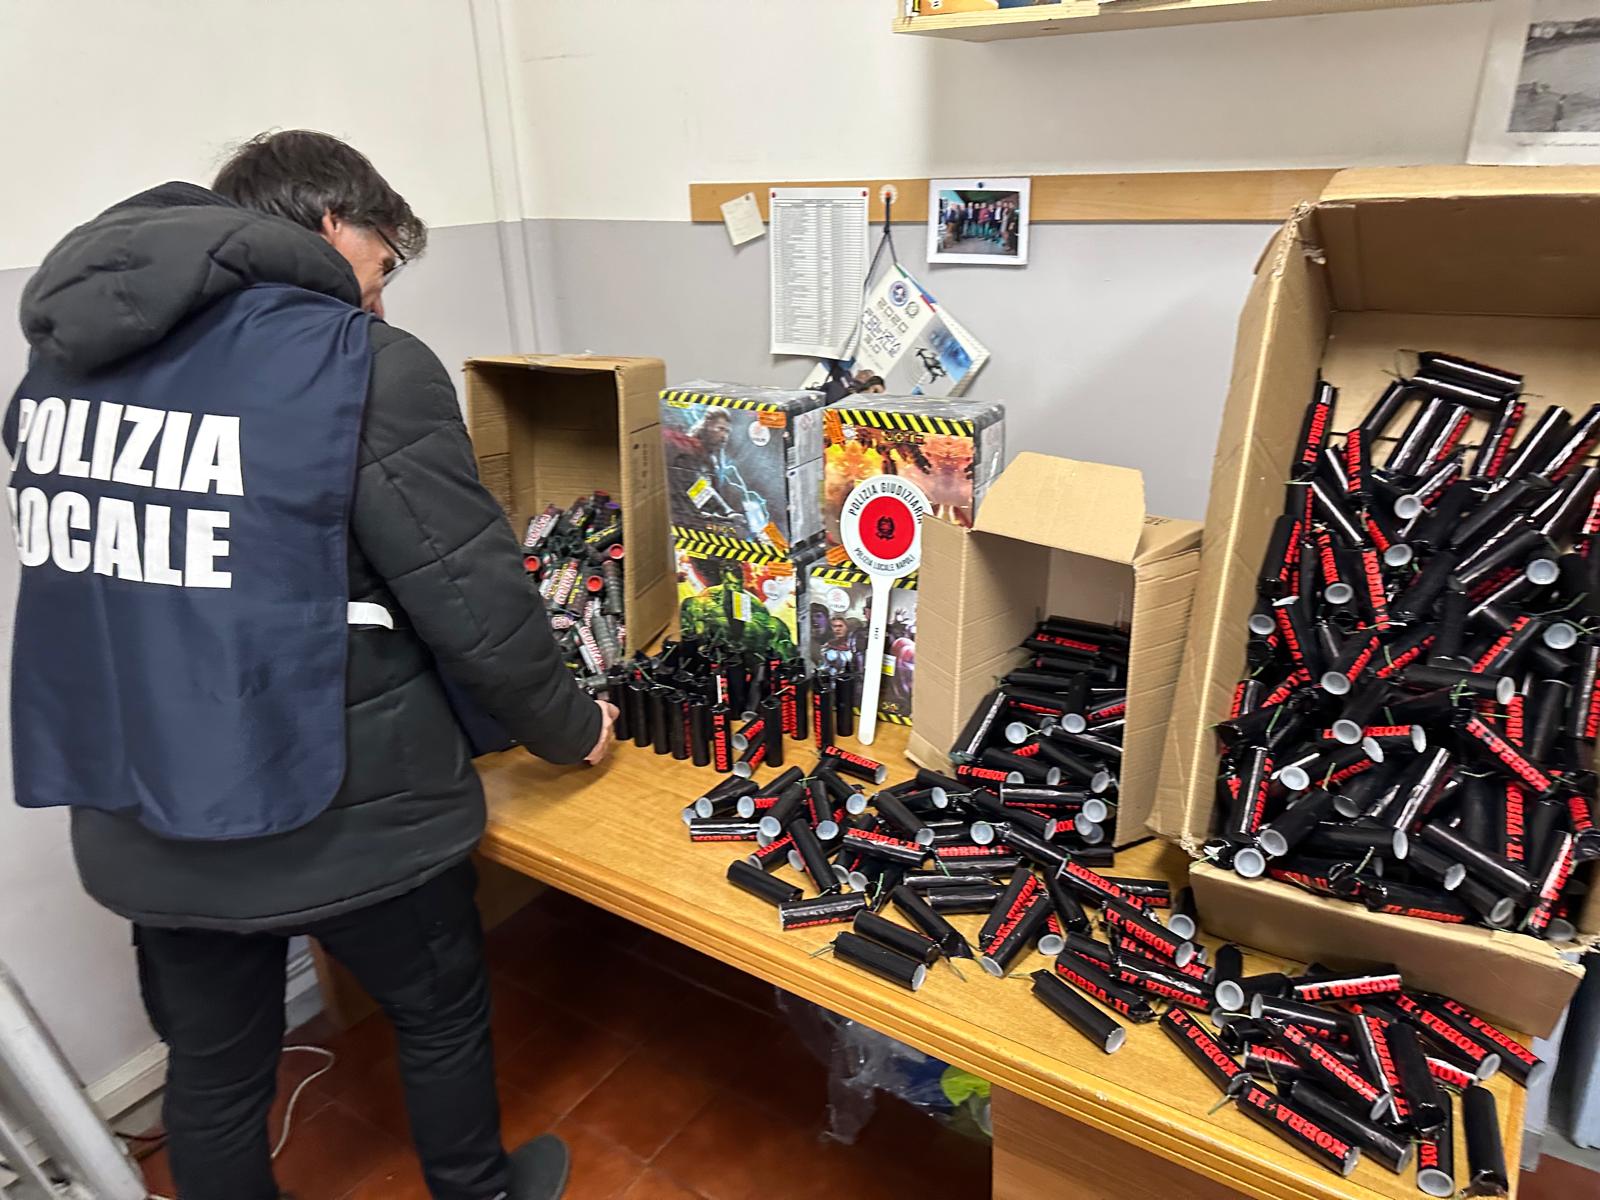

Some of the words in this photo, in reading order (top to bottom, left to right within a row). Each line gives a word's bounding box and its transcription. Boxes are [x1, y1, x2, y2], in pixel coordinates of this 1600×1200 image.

[11, 396, 245, 497] POLIZIA
[847, 484, 879, 517] POLIZIA
[1362, 550, 1387, 609] KOBRA
[714, 730, 728, 770] KOBRA
[1489, 737, 1552, 792] KOBRA
[1065, 862, 1121, 898] KOBRA
[1124, 919, 1177, 957] KOBRA
[1057, 964, 1107, 1003] KOBRA
[1145, 979, 1209, 1009] KOBRA
[1186, 1025, 1242, 1078] KOBRA
[1419, 1009, 1488, 1061] KOBRA
[1469, 1016, 1539, 1065] KOBRA
[1310, 1043, 1380, 1102] KOBRA
[1247, 1087, 1271, 1109] 11
[1275, 1104, 1349, 1159] KOBRA
